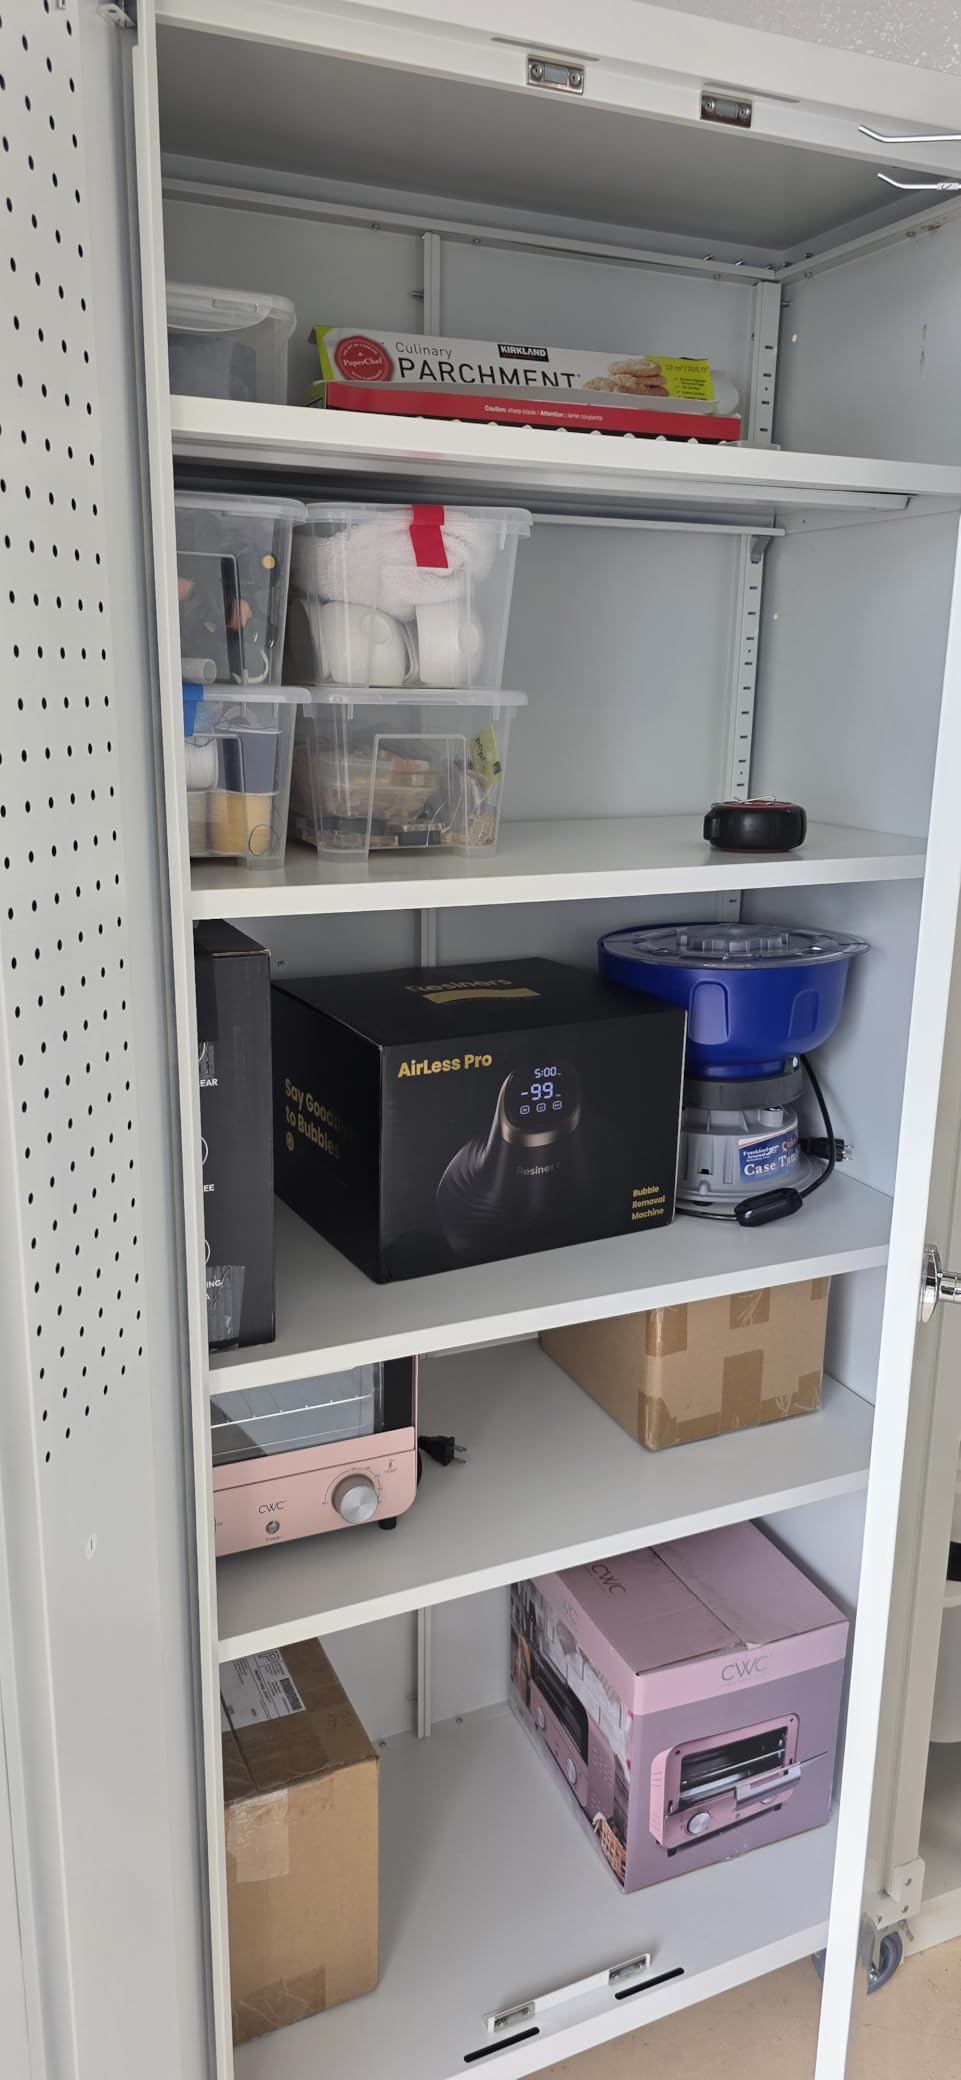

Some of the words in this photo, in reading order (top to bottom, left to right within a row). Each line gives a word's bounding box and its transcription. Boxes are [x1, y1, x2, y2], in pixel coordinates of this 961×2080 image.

[396, 342, 452, 359] Culinary
[500, 346, 547, 357] KIRKLAND
[343, 358, 383, 368] PaperChef
[398, 357, 575, 388] PARCHMENT
[484, 404, 507, 413] Caution:
[540, 410, 564, 418] Attention
[398, 1058, 461, 1078] AirLess
[464, 1054, 493, 1070] Pro
[534, 1066, 557, 1078] 5:00
[285, 1078, 304, 1111] Say
[286, 1104, 296, 1127] to
[744, 1162, 776, 1176] Case
[633, 1186, 660, 1197] Bubble
[632, 1195, 666, 1209] Removal
[631, 1208, 665, 1220] Machine
[258, 1501, 284, 1514] CWC
[592, 1564, 626, 1594] CWC
[721, 1656, 769, 1681] CWC
